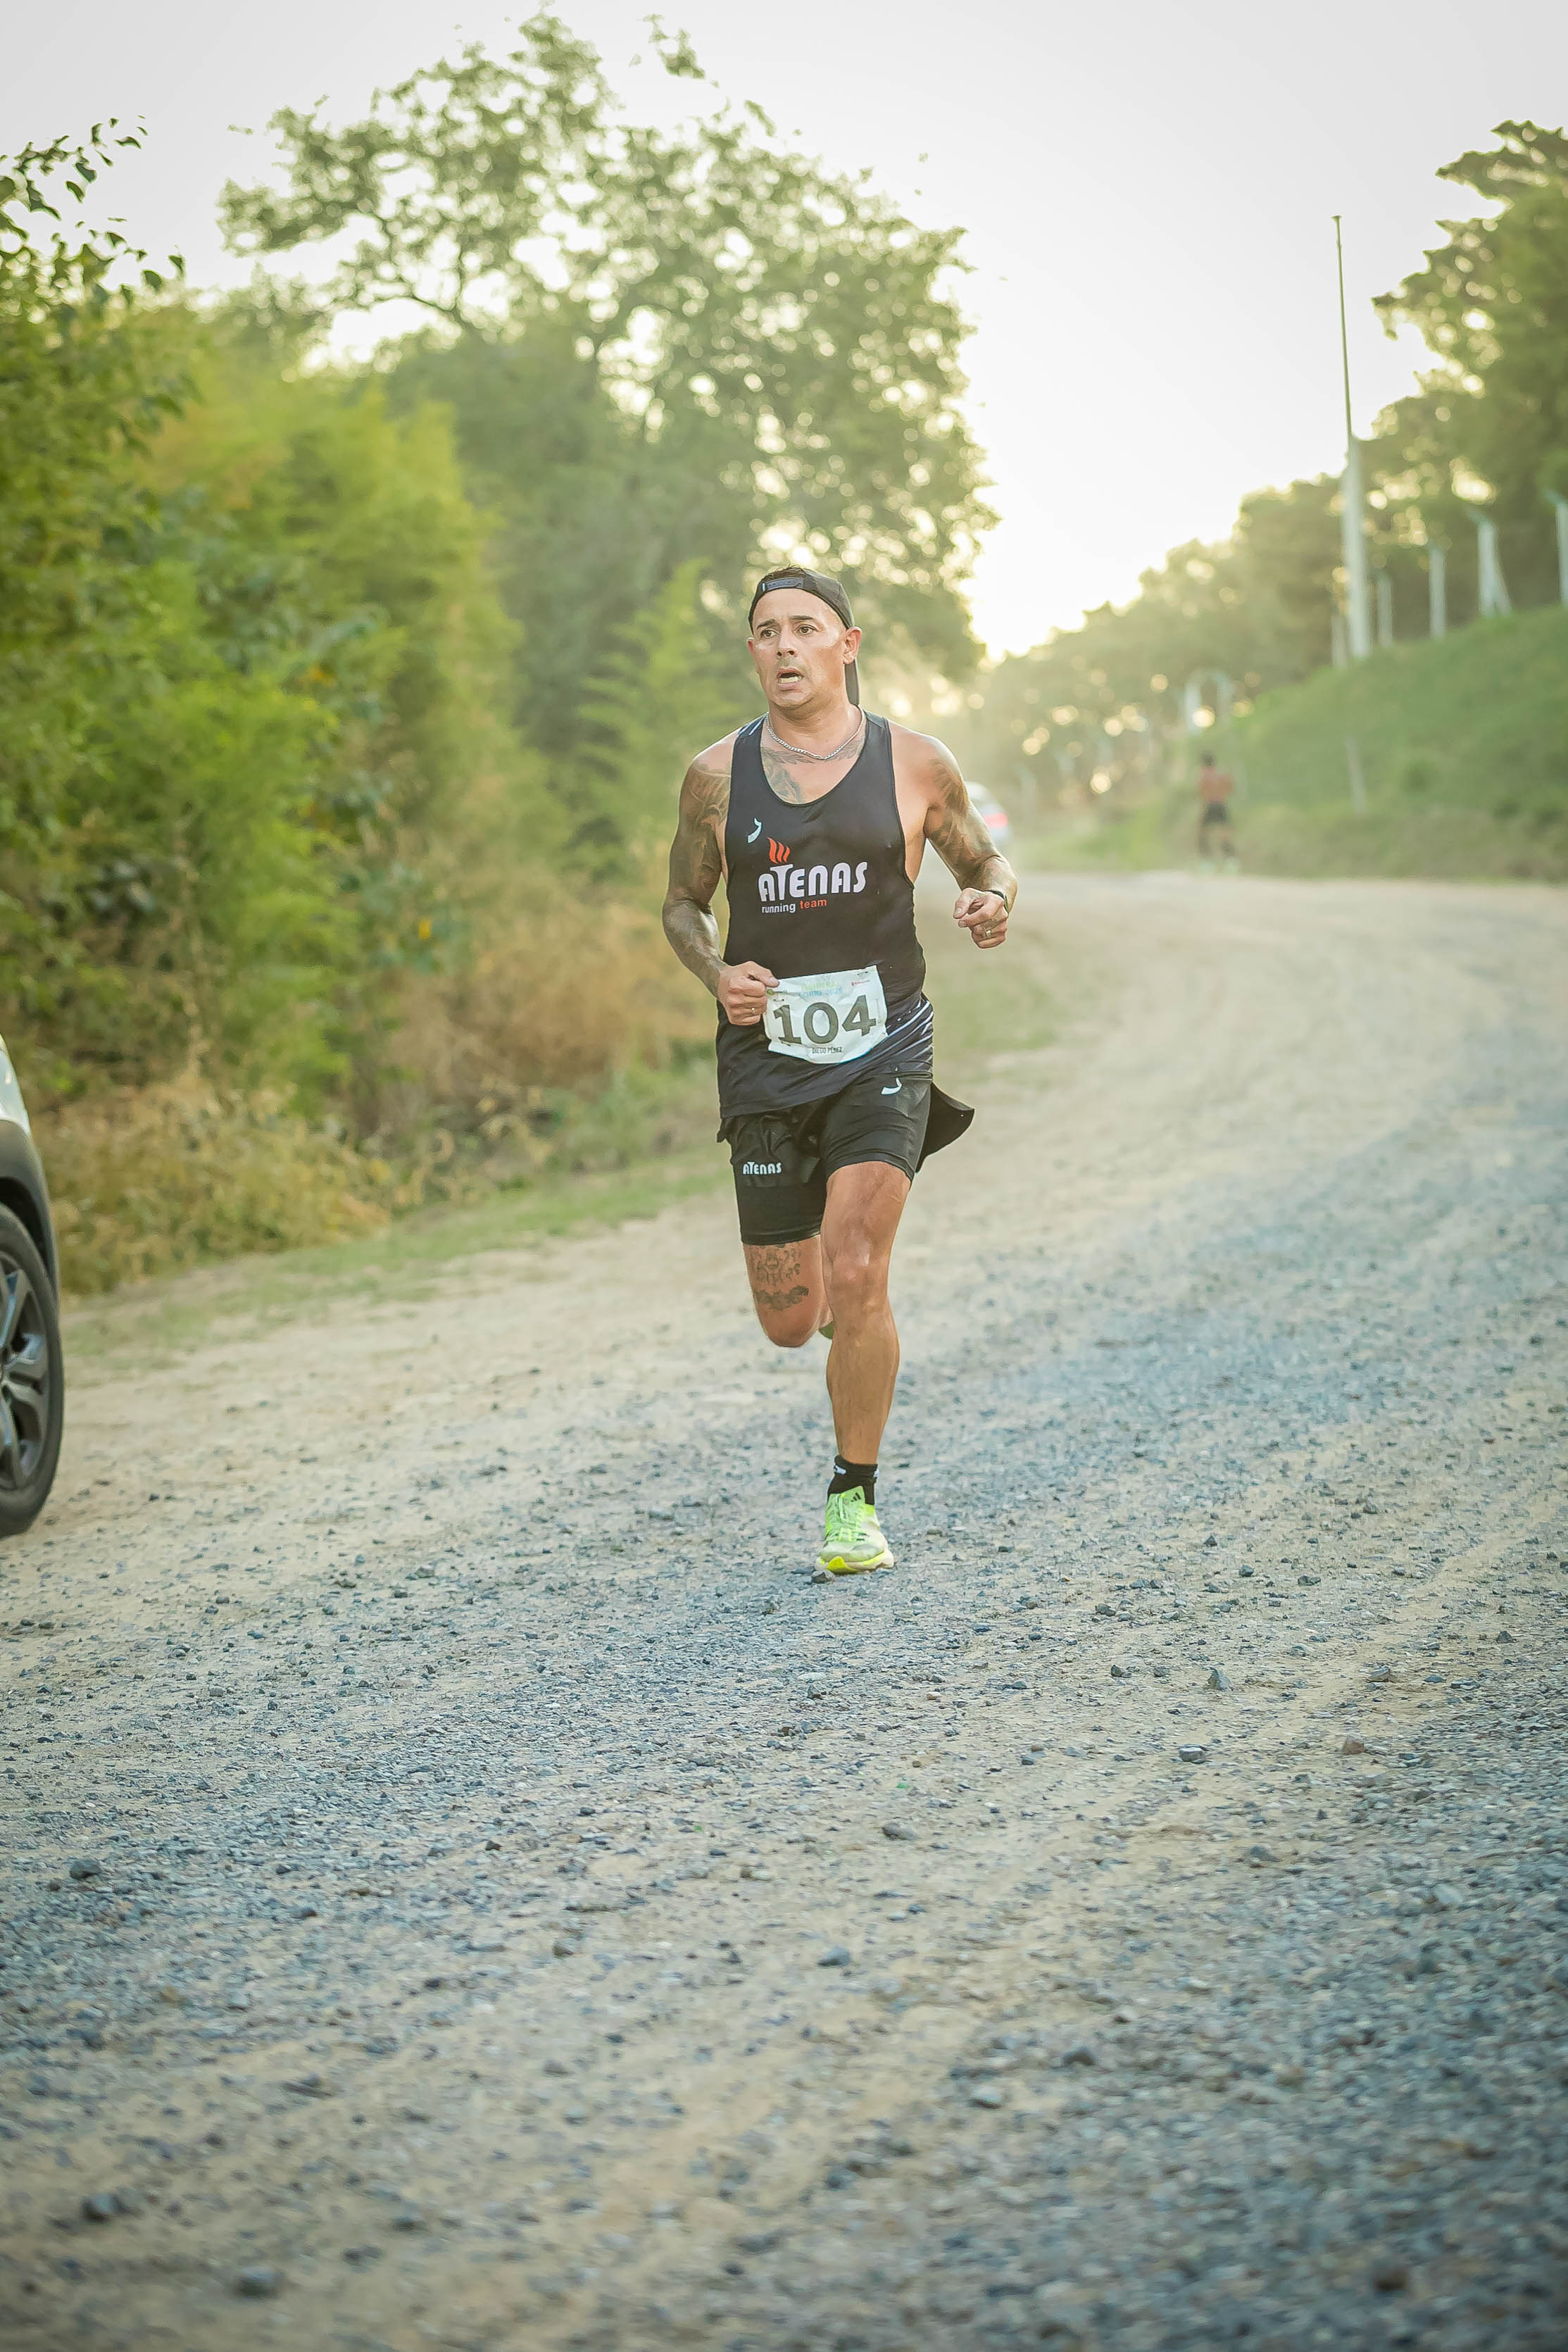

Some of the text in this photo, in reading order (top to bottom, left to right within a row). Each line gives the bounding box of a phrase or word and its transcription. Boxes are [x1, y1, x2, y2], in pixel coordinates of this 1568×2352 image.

[758, 862, 867, 901] ATENAS
[762, 899, 827, 913] running team
[773, 995, 876, 1044] 104
[743, 1161, 782, 1175] ATENAS
